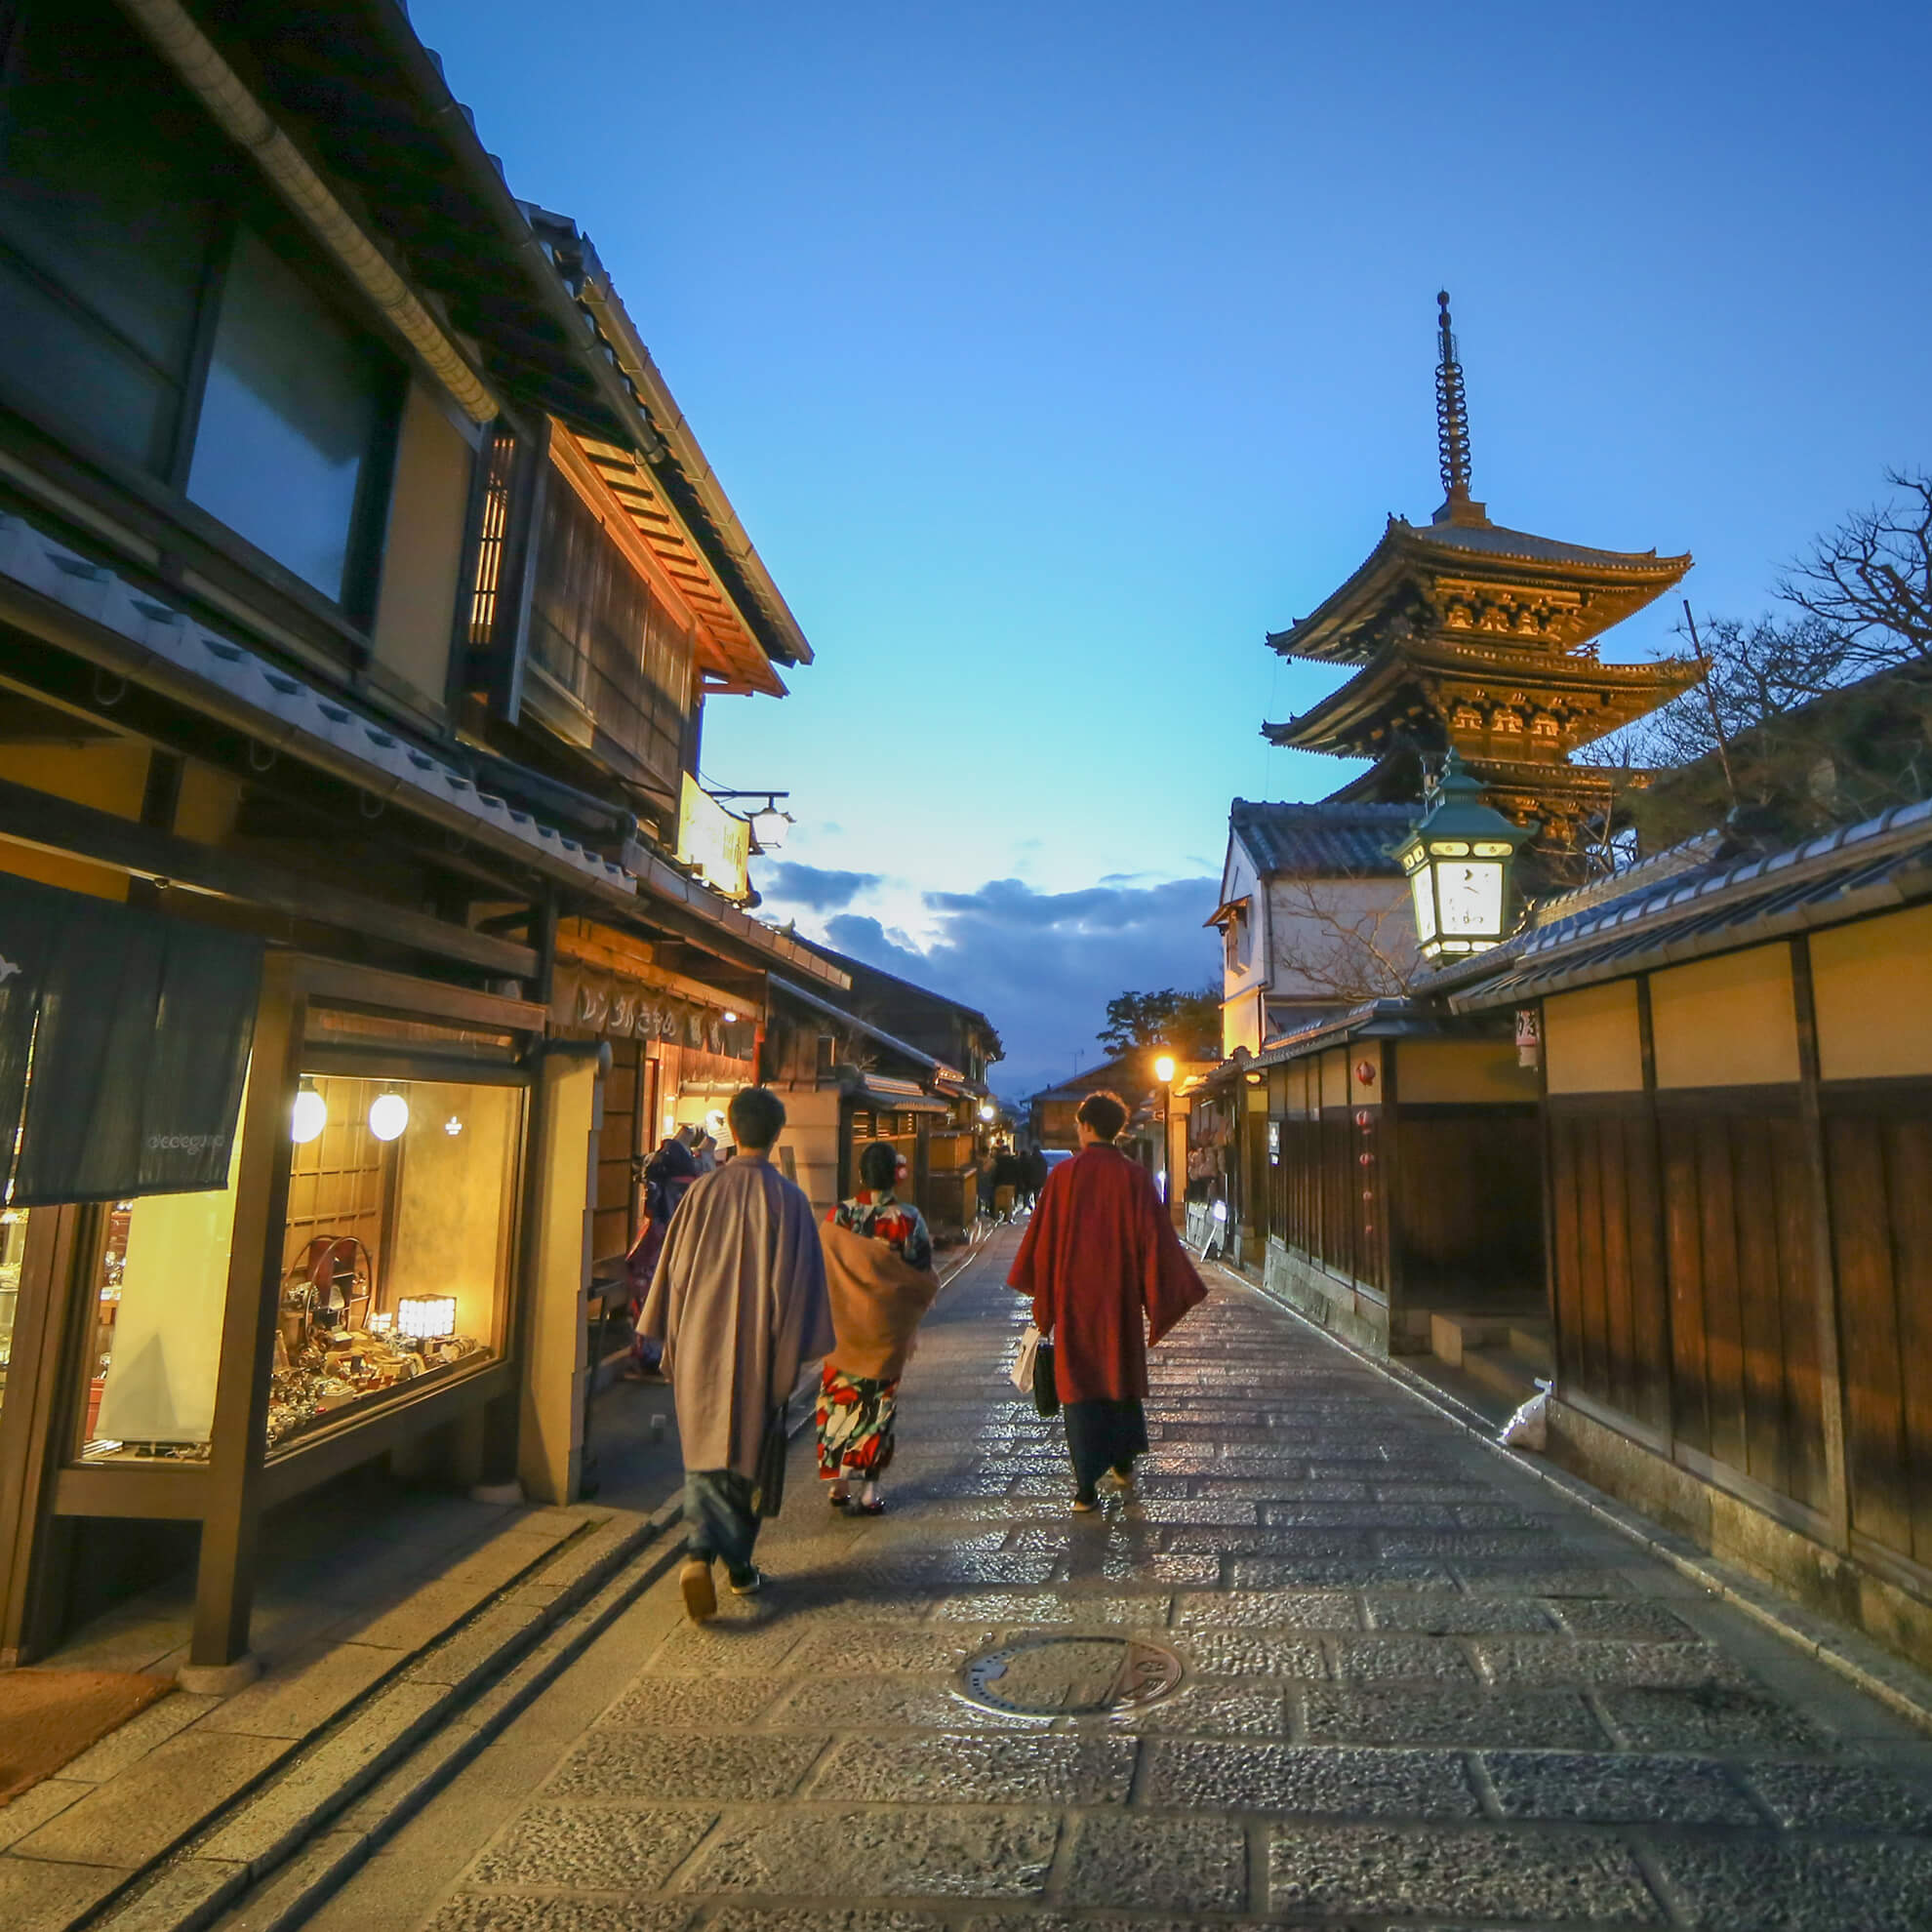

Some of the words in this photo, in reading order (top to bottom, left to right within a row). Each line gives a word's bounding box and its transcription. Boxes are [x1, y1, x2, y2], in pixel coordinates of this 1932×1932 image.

[583, 987, 677, 1036] レンタルきもの
